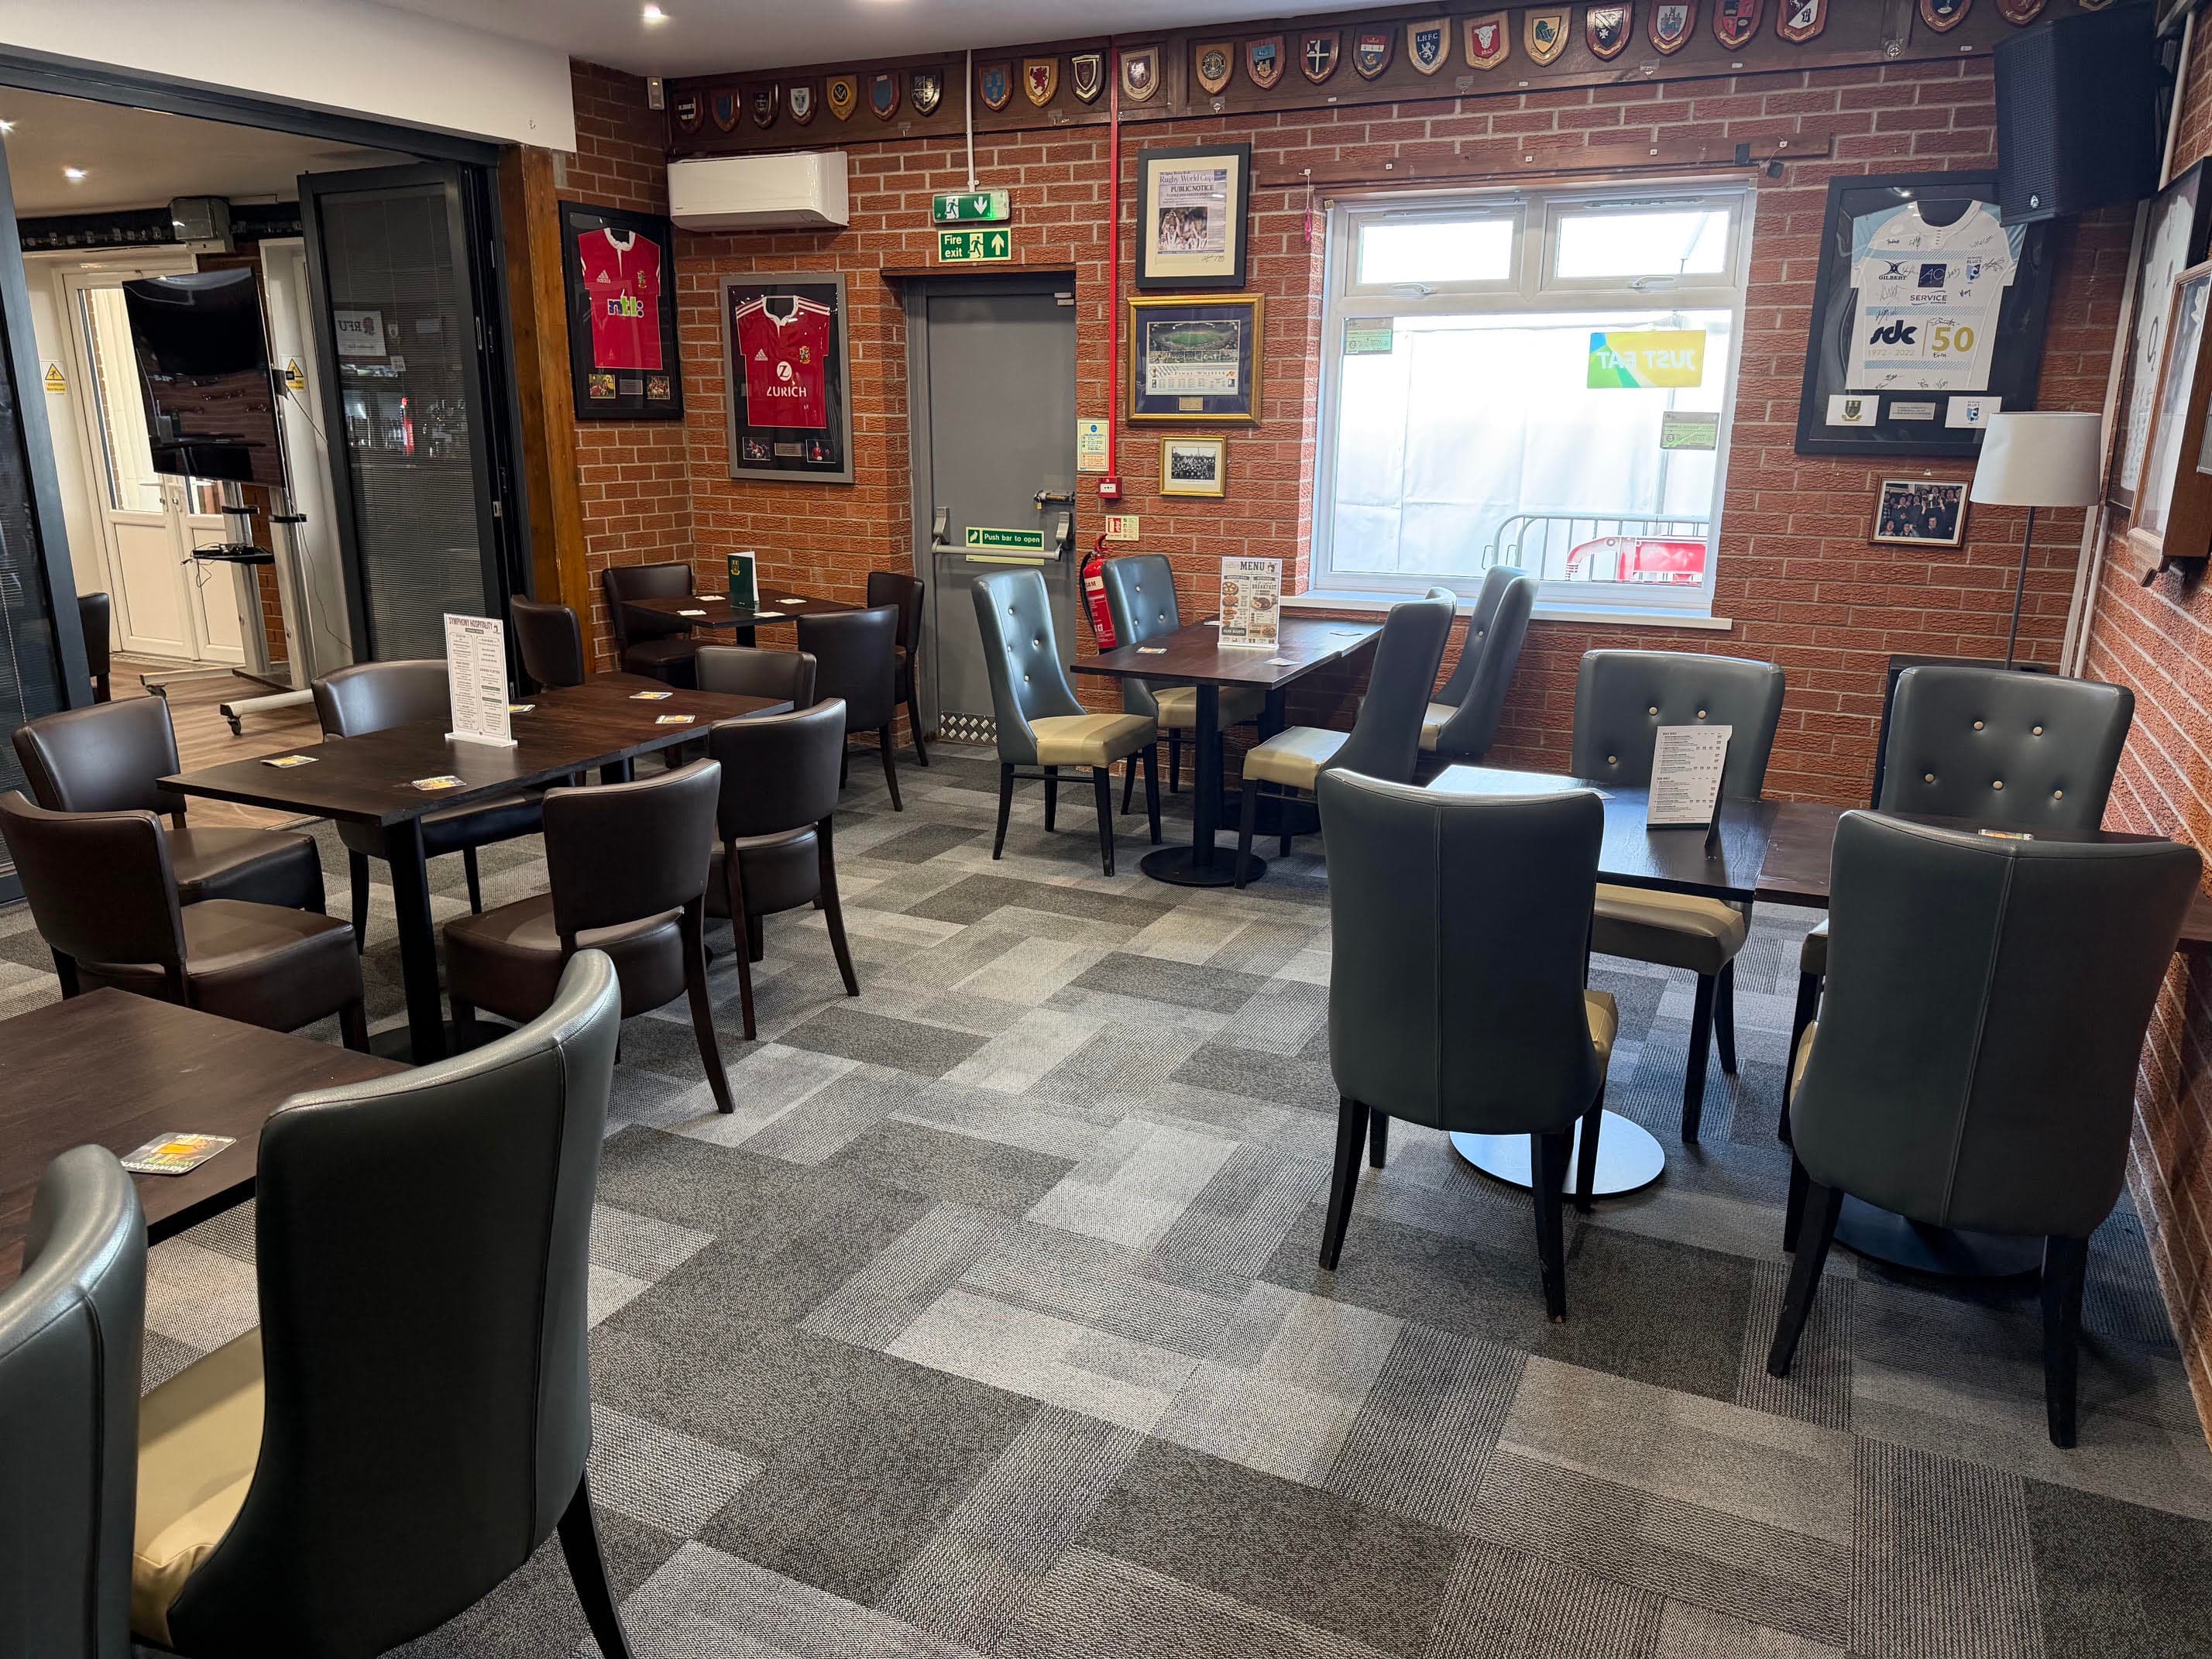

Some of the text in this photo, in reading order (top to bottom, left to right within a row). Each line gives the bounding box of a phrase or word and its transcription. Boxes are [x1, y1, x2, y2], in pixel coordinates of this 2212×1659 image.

[1417, 33, 1438, 42] LRFC
[1159, 175, 1178, 184] Rugby
[1180, 174, 1199, 183] World
[1200, 173, 1214, 183] Cup
[944, 235, 962, 245] Fire
[945, 248, 963, 258] exit
[1870, 319, 1974, 352] sdc 50
[766, 386, 807, 397] ZURICH
[1240, 561, 1265, 571] MENU
[448, 617, 493, 630] SYMPHONY HOSPITALITY
